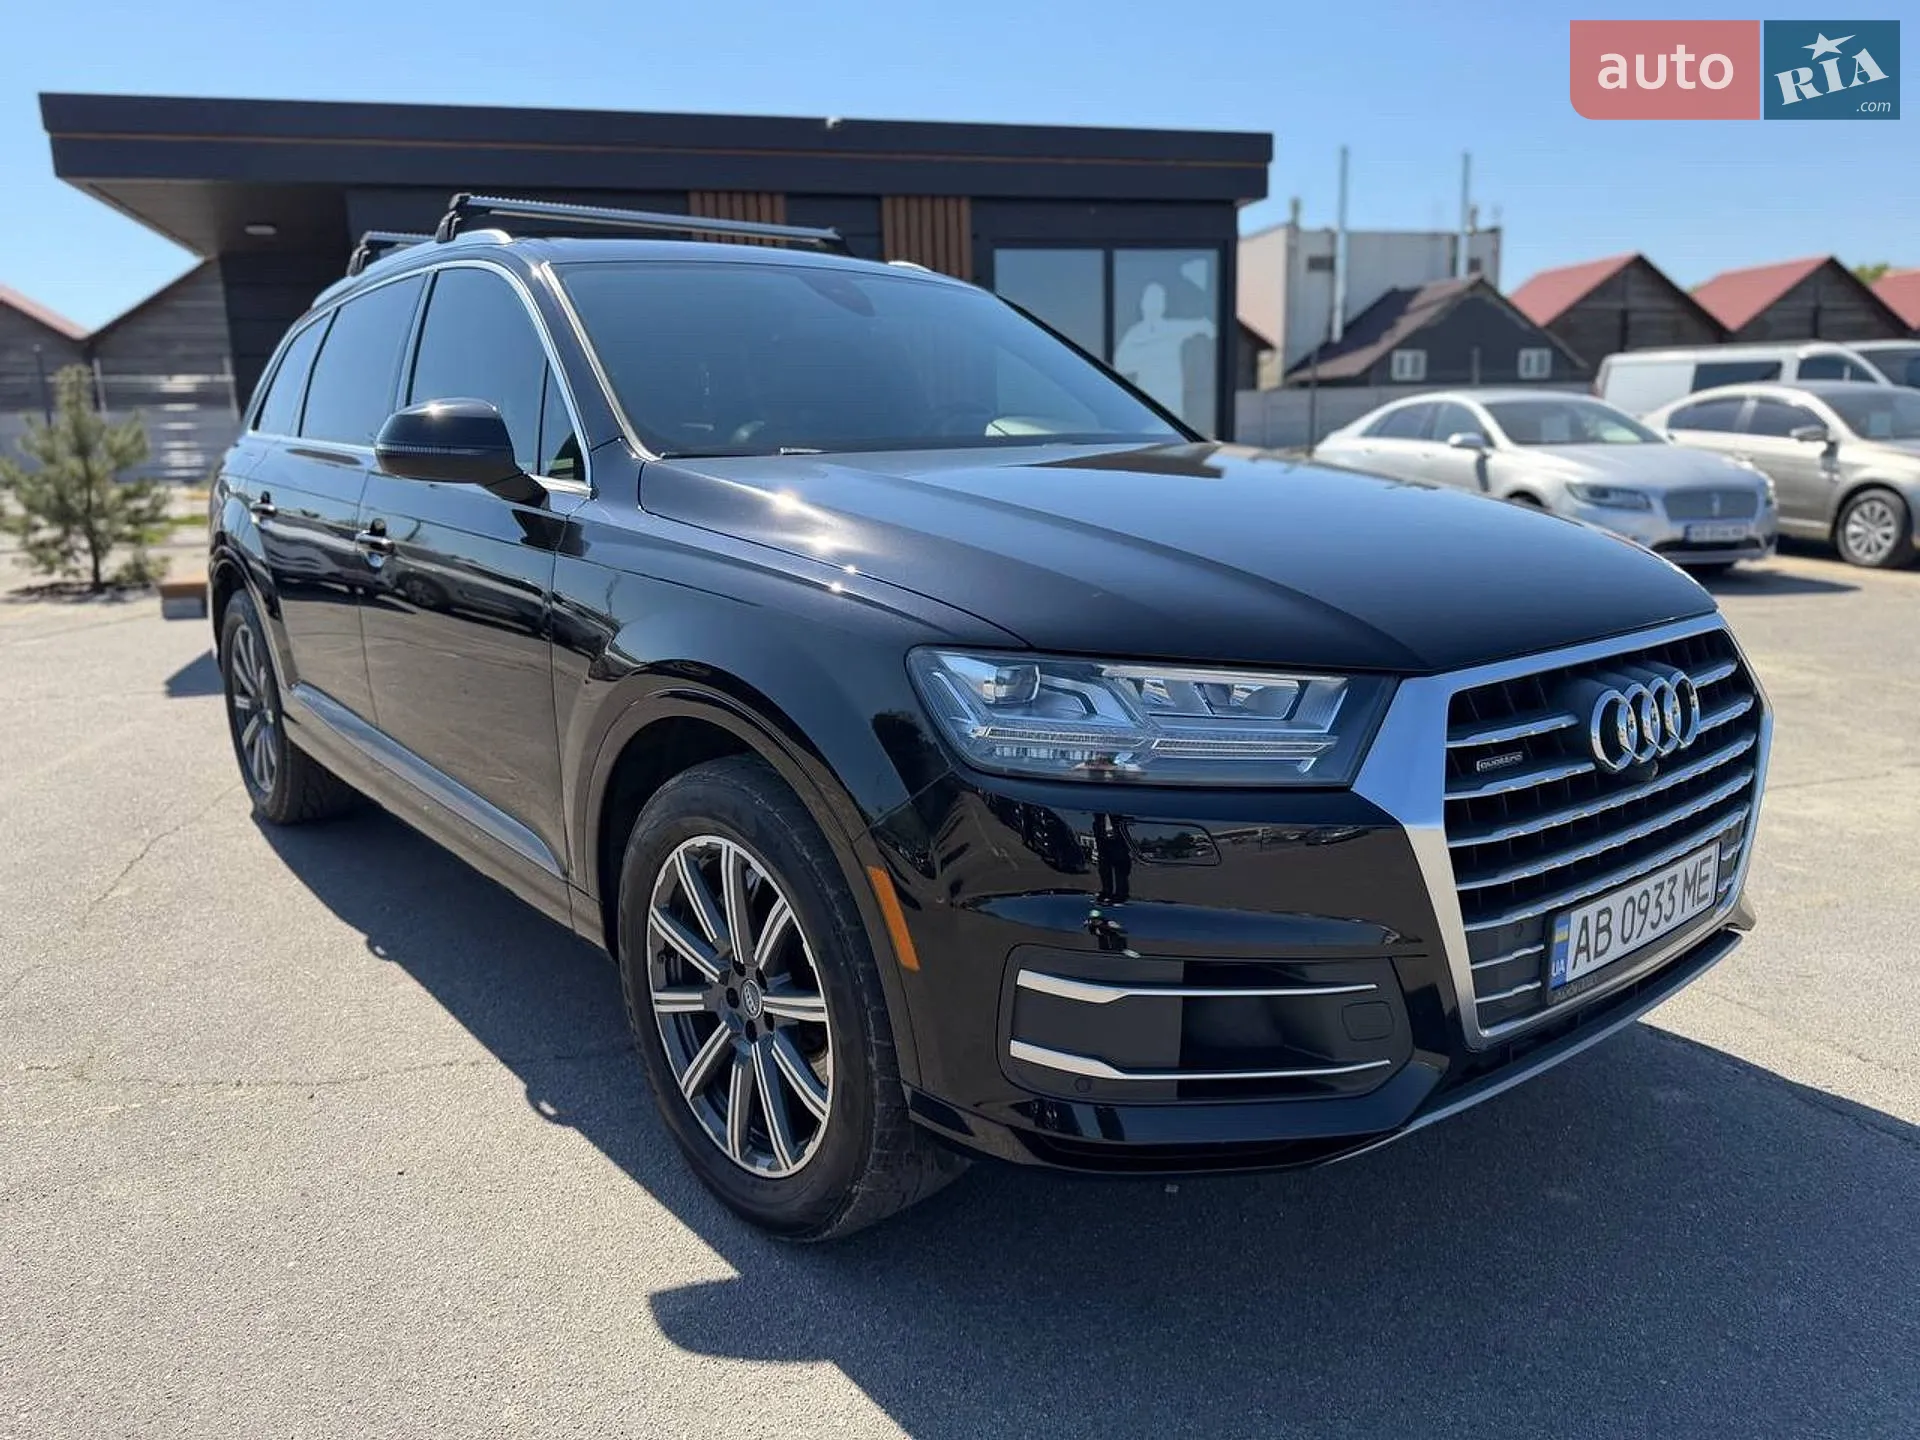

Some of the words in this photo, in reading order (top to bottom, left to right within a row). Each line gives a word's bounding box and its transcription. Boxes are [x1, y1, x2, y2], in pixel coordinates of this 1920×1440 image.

[1572, 907, 1613, 970] AB
[1621, 874, 1678, 944] 0933
[1682, 855, 1713, 914] ME
[1551, 958, 1567, 977] UA
